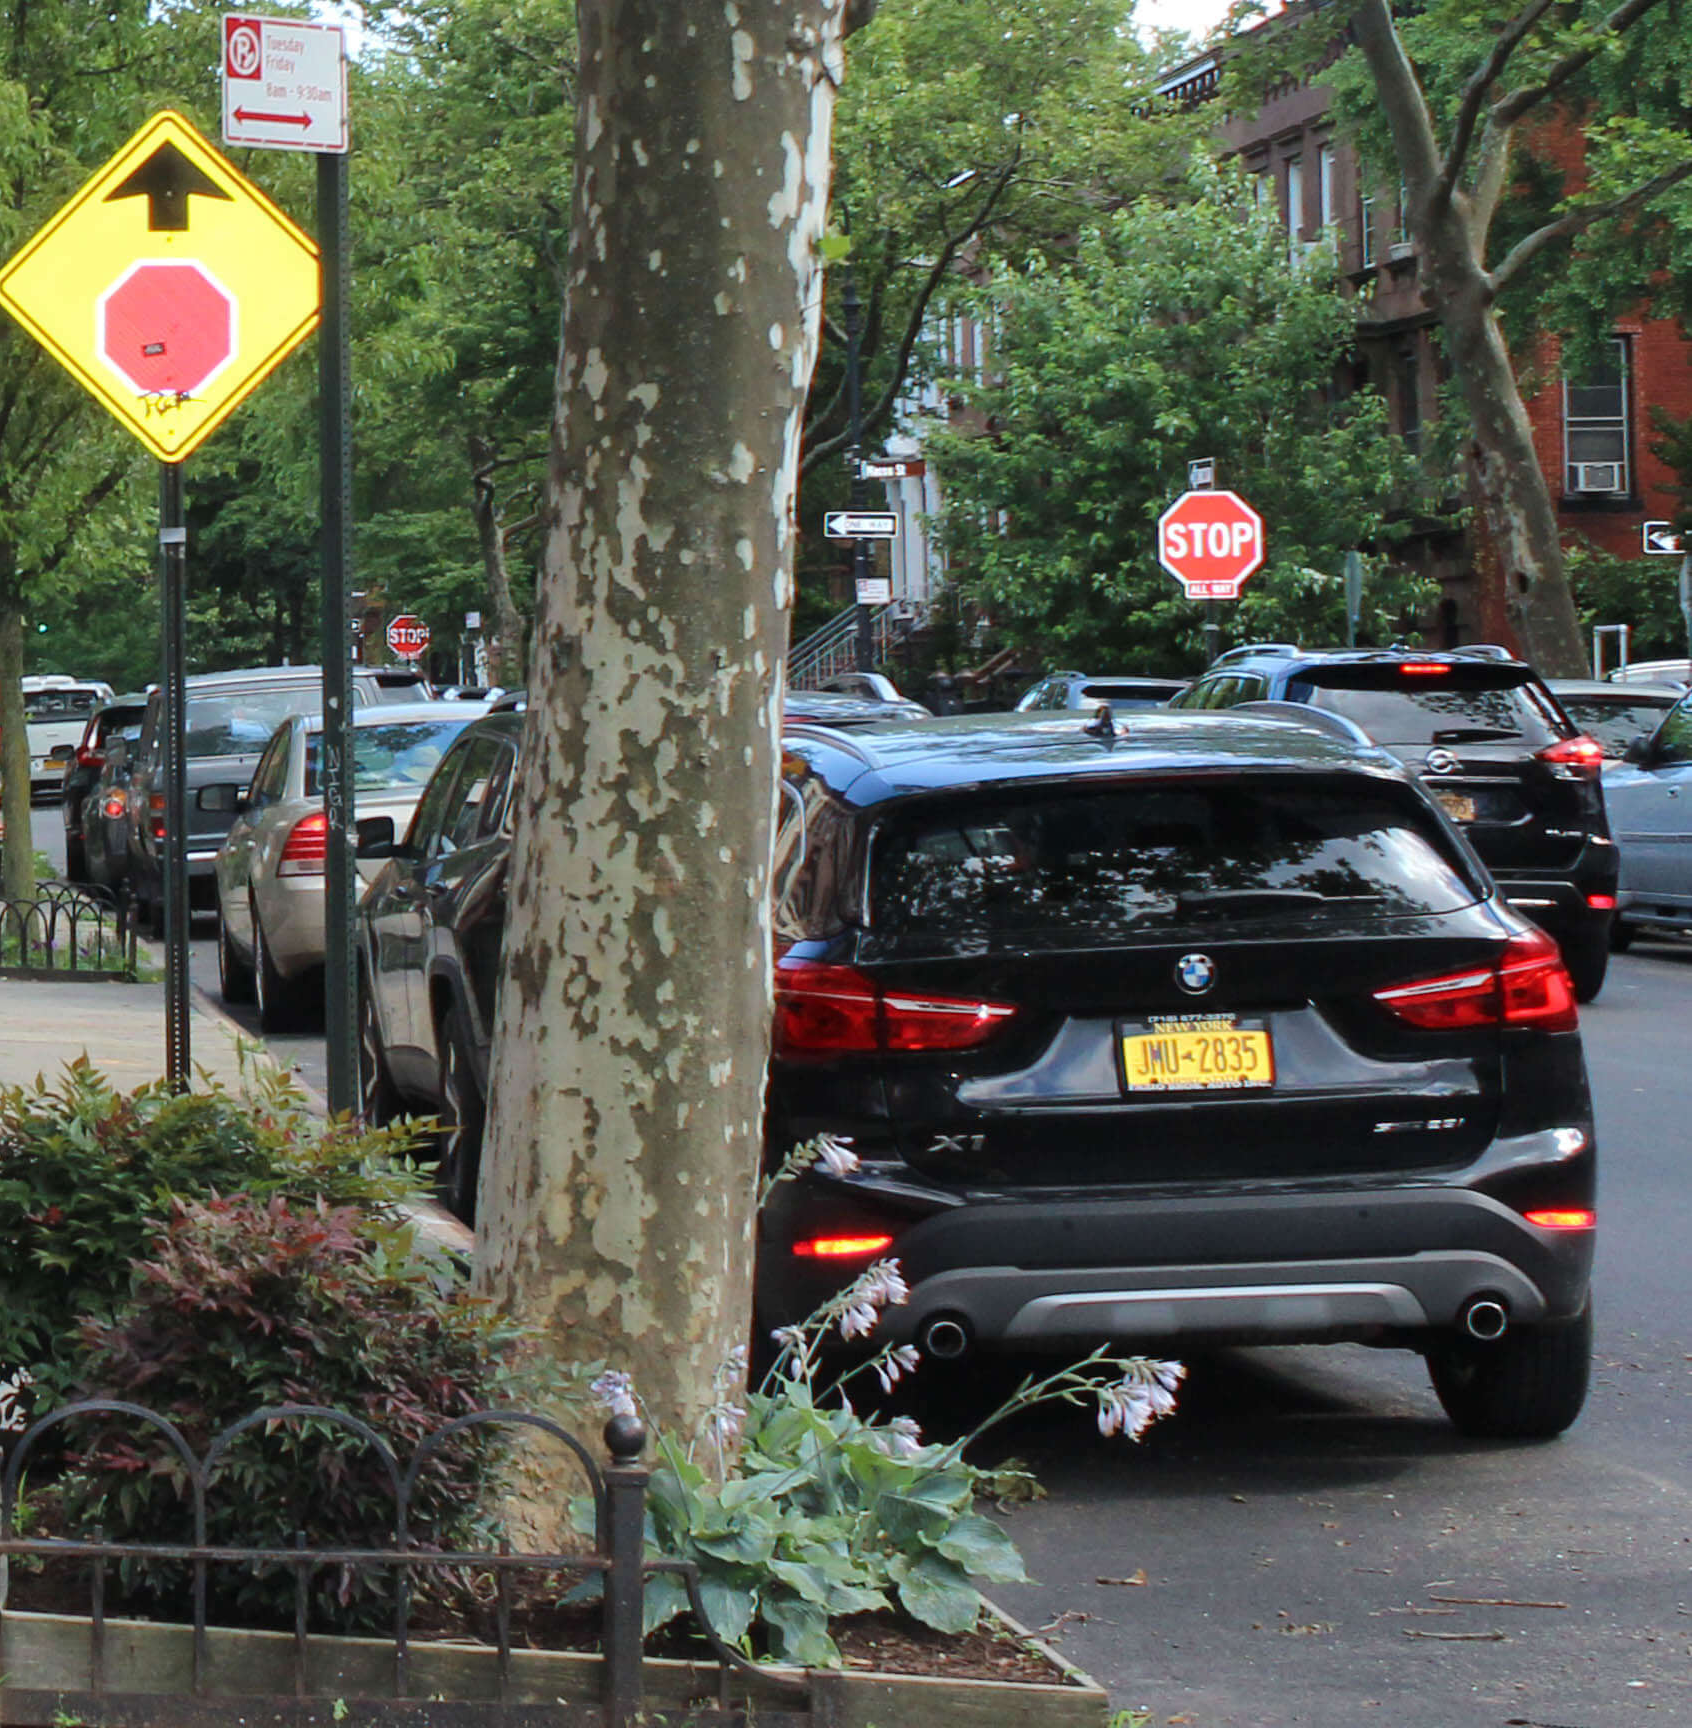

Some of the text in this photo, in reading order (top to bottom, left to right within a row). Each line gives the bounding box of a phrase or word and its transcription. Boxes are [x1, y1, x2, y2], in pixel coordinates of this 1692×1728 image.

[266, 34, 305, 56] Tuesday
[266, 54, 295, 75] Friday
[266, 81, 288, 99] 8am
[296, 84, 333, 102] 9:30am
[844, 518, 889, 529] ONE WAY
[1165, 521, 1255, 559] STOP
[1190, 584, 1232, 594] ALL WAY
[389, 628, 427, 644] STOP
[1154, 1020, 1234, 1033] NEW YORK
[926, 1133, 987, 1152] X1
